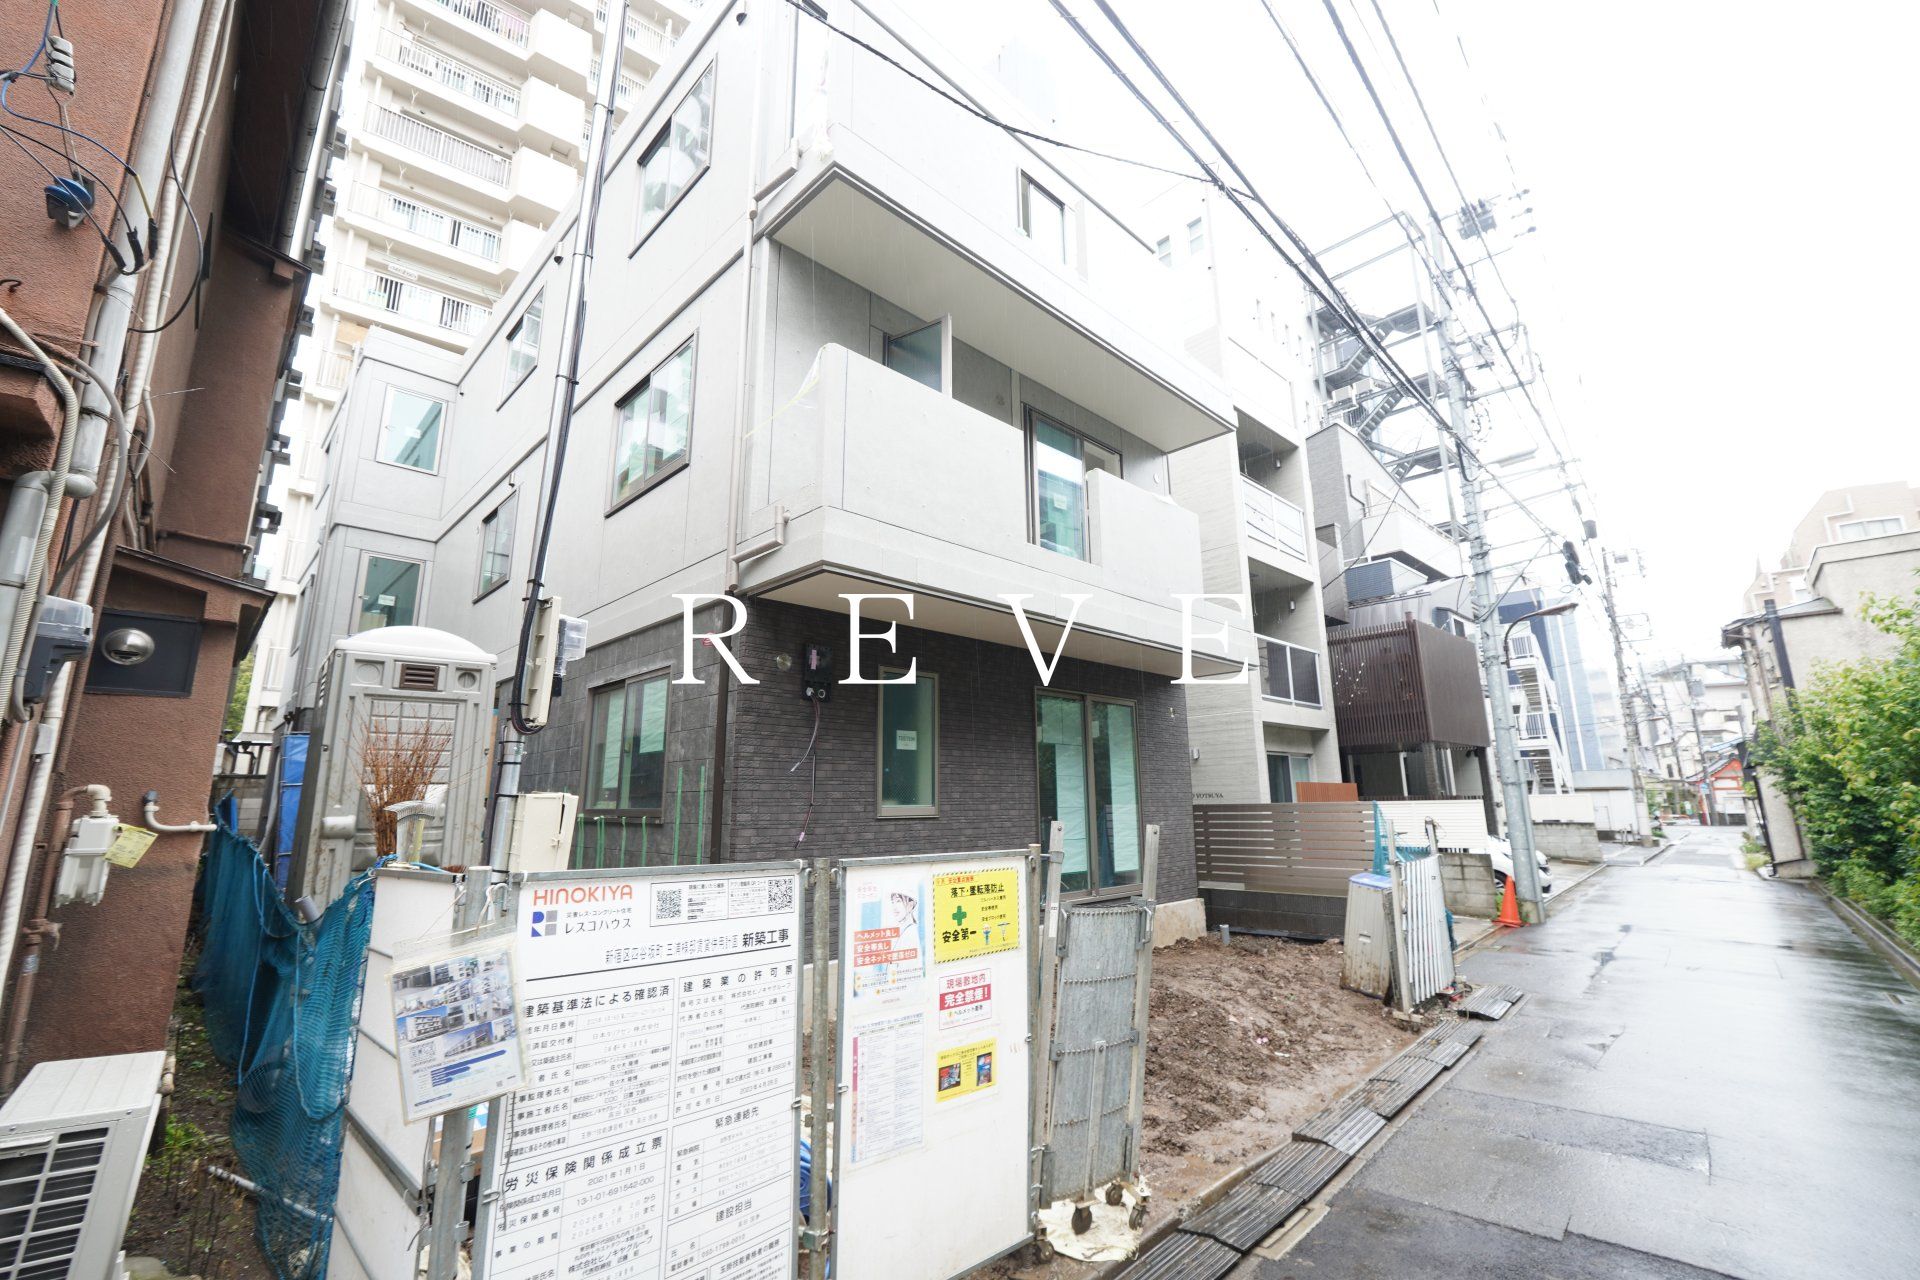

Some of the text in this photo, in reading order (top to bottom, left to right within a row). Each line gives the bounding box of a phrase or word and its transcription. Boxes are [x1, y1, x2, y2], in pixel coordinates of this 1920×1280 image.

[533, 884, 633, 906] HINOKIYA
[565, 918, 631, 934] レスコハウス
[942, 928, 977, 943] 安全第一
[742, 928, 789, 948] 新築工事
[505, 1136, 663, 1192] 労災保険関係成立票
